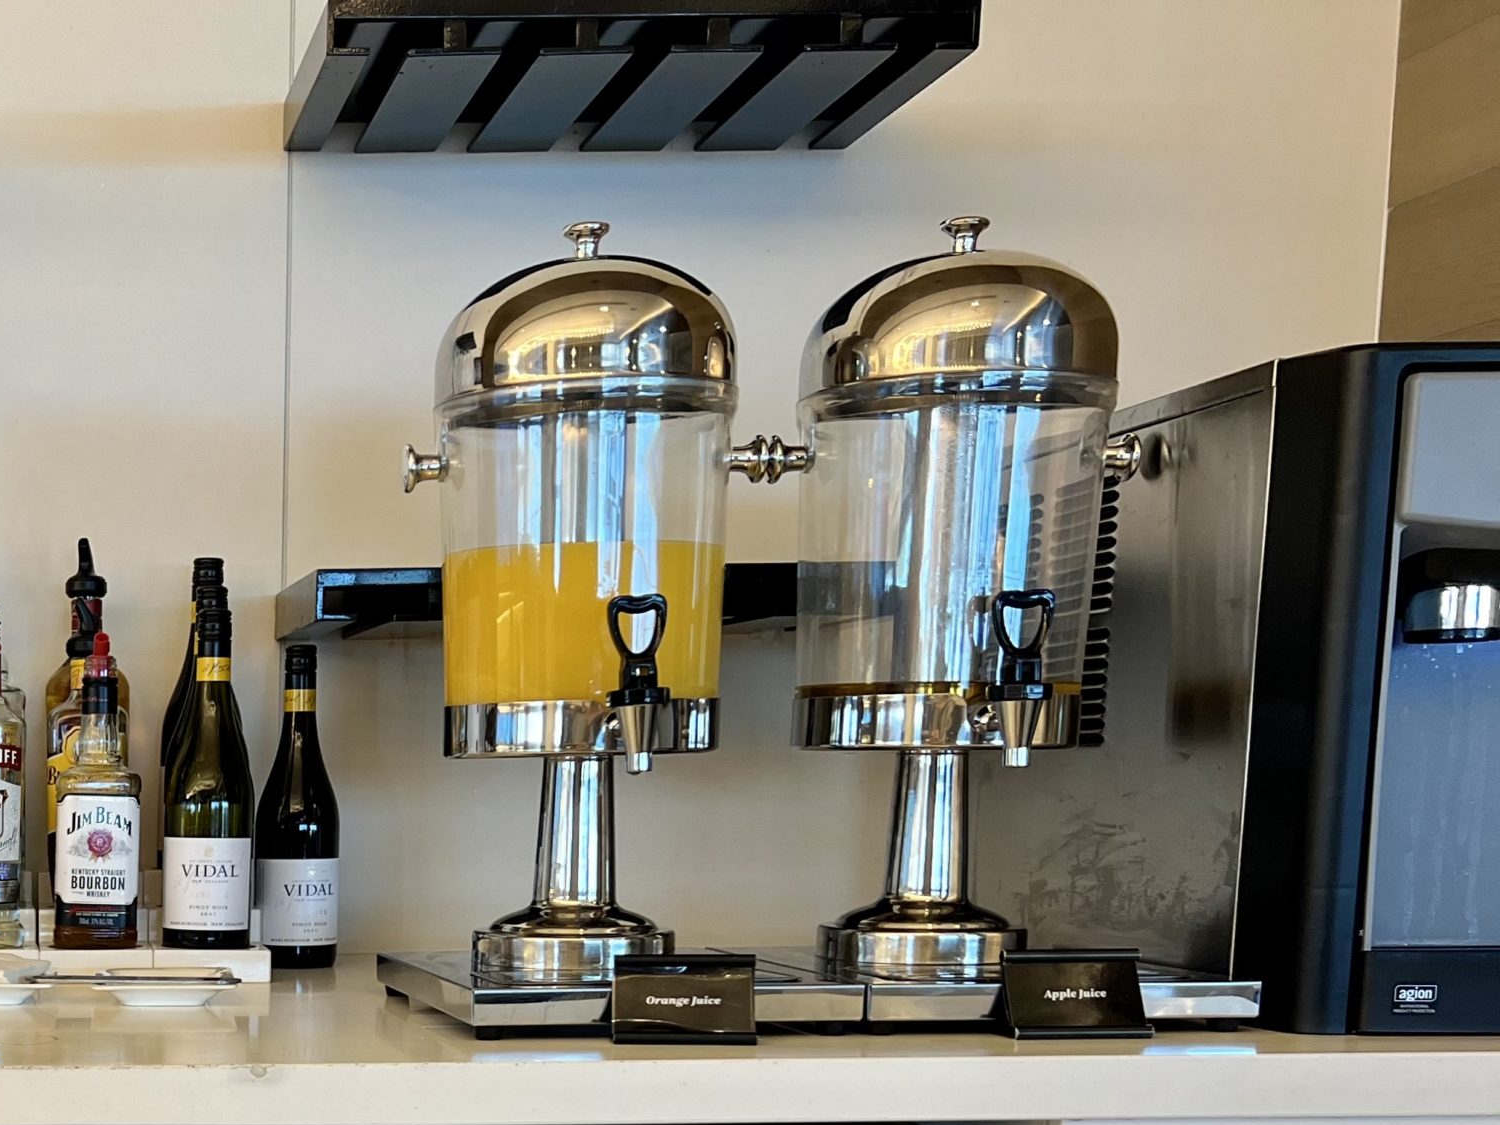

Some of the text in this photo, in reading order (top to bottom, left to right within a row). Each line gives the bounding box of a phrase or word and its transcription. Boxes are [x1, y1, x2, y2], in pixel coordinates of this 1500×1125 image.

[66, 806, 133, 837] JIM BEAM
[71, 868, 127, 876] KENTUCKY STRAIGHT
[182, 864, 240, 878] VIDAL
[71, 875, 126, 891] BOURBON
[284, 883, 335, 897] VIDAL
[86, 890, 111, 898] WHISKEY
[1043, 987, 1107, 1001] Apple Juice
[1398, 985, 1433, 1002] agion
[645, 995, 722, 1008] Orange Juice
